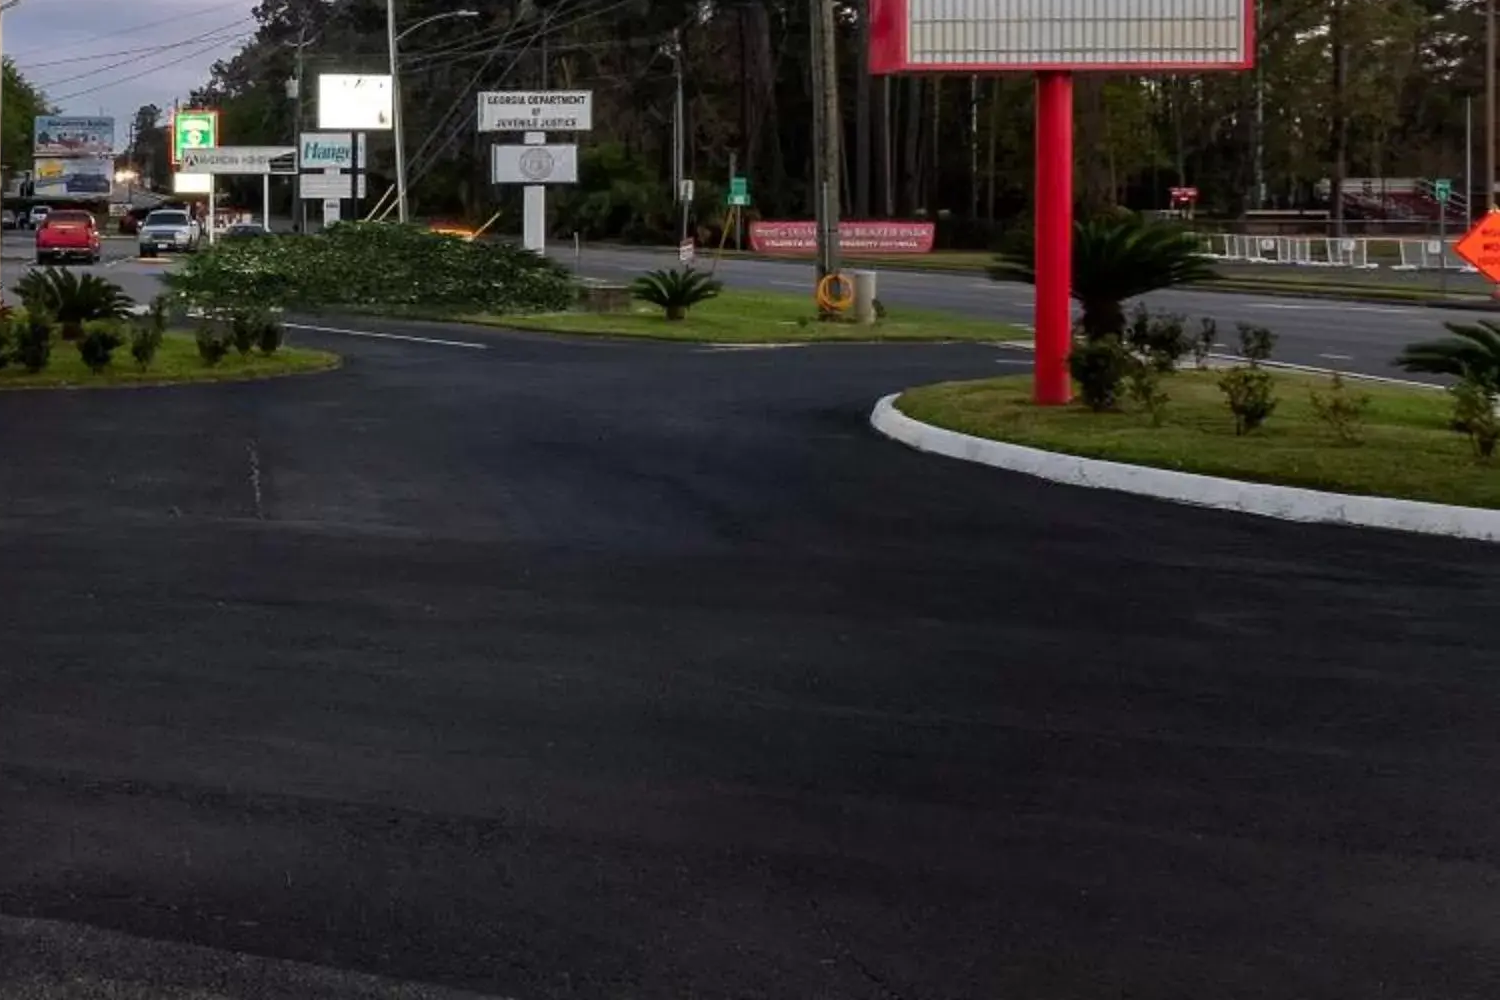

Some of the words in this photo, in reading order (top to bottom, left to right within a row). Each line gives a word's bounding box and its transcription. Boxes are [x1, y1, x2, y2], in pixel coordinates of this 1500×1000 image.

[487, 95, 525, 105] GEORGIA
[528, 95, 586, 105] DEPARTMENT
[495, 118, 538, 127] JUVENILE
[540, 118, 576, 127] JUSTICE
